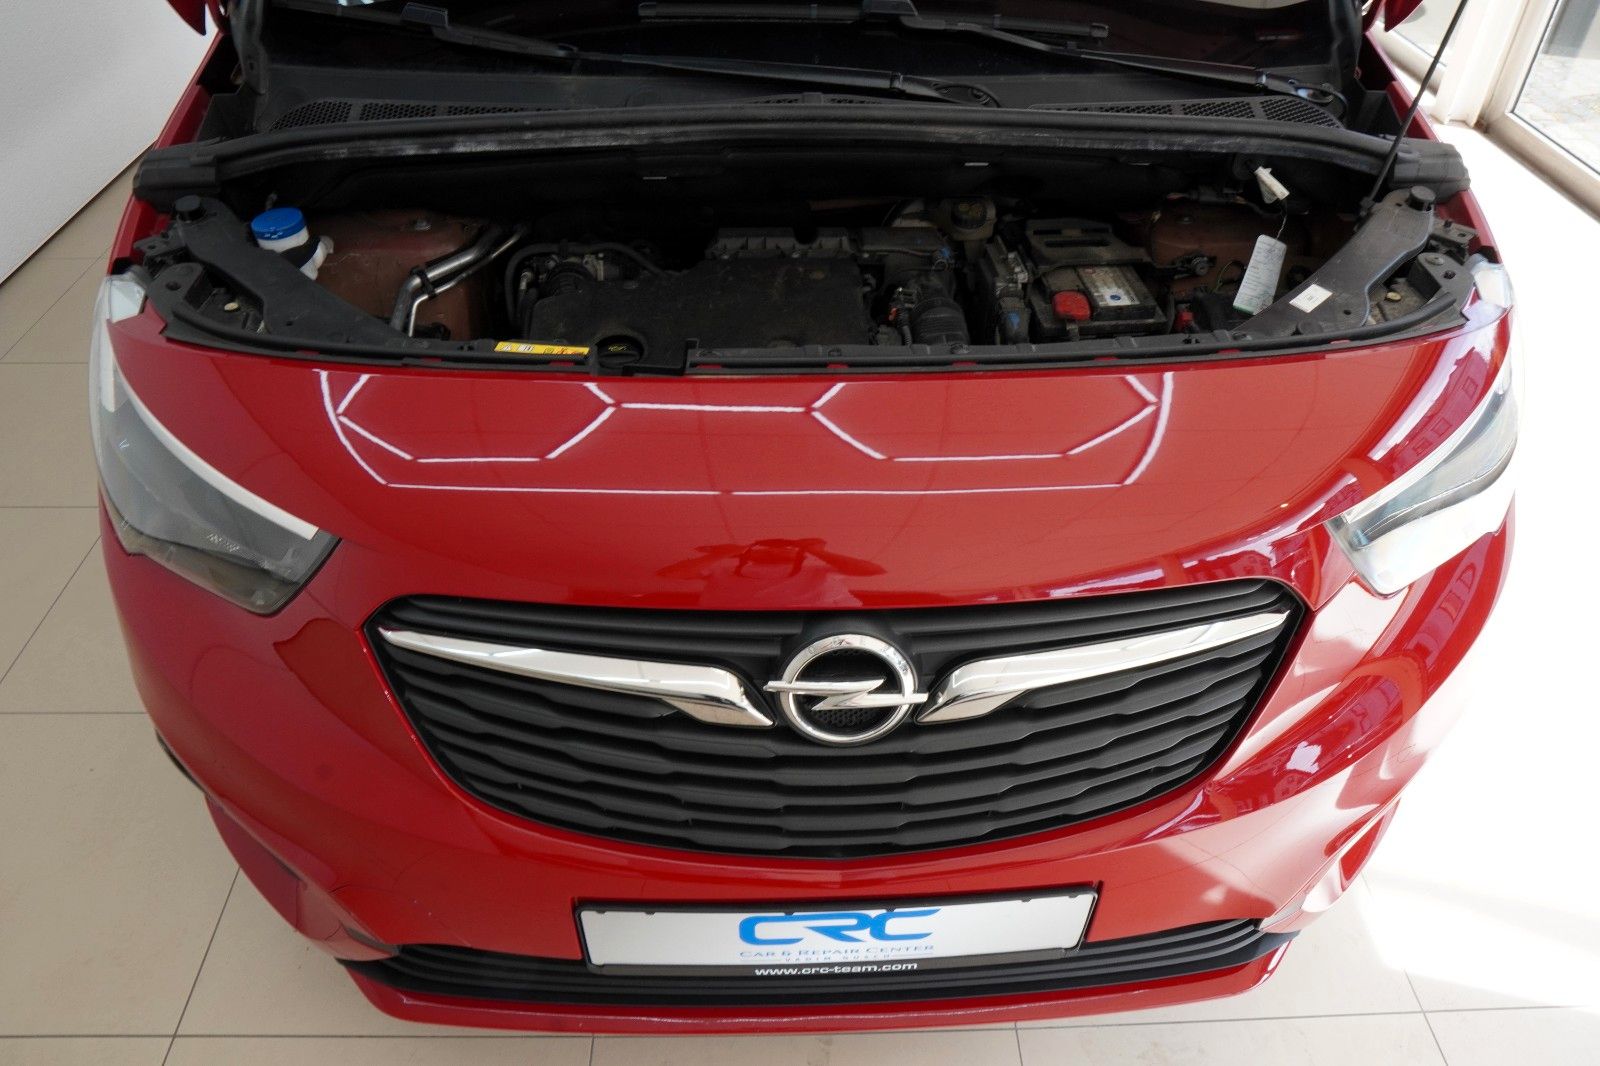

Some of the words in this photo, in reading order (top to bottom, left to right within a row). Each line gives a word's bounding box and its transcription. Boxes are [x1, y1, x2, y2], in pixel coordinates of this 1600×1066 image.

[740, 909, 940, 945] CRC
[866, 945, 934, 953] CENTER
[755, 963, 918, 975] www.crc-team.com
